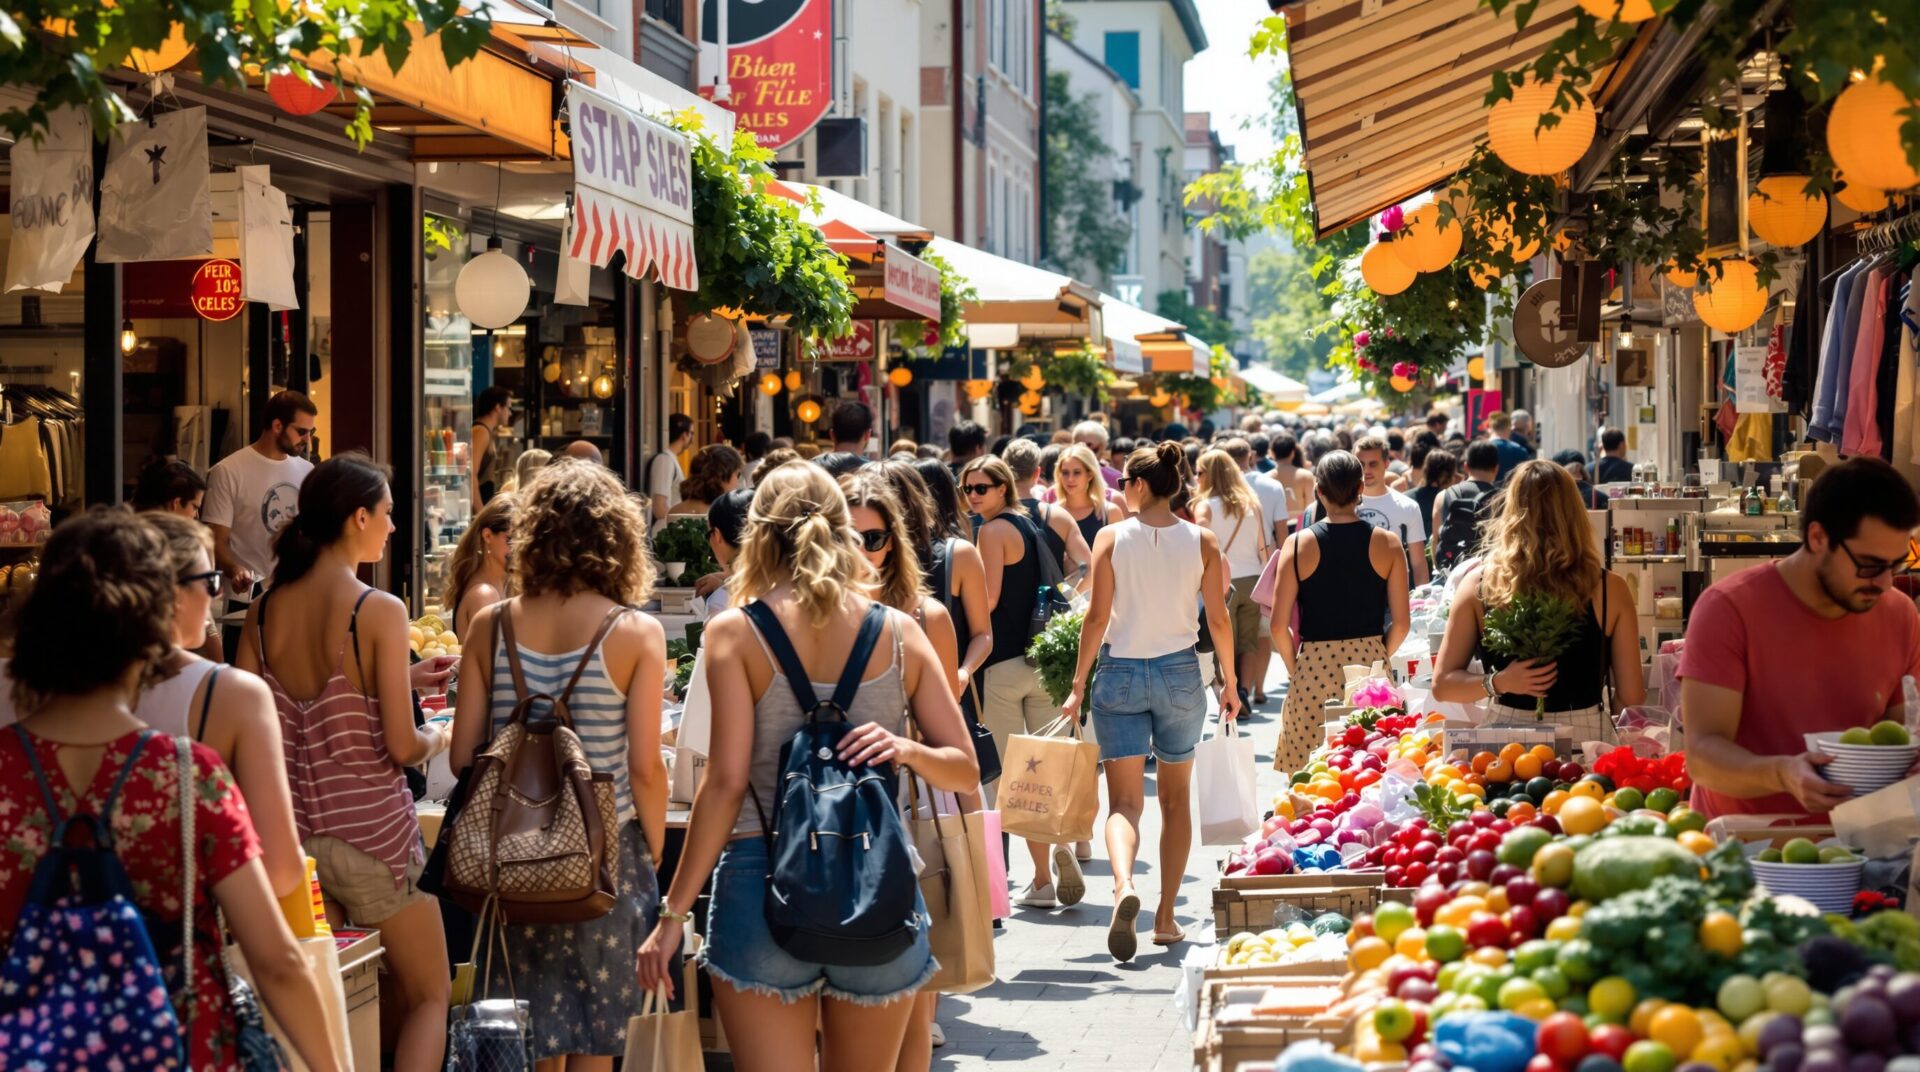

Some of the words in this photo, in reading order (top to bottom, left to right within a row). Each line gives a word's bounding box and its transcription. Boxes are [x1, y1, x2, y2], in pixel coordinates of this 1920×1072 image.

[737, 112, 789, 128] ALES
[579, 102, 641, 188] STAP
[646, 130, 688, 211] SAES
[198, 296, 235, 311] CELES
